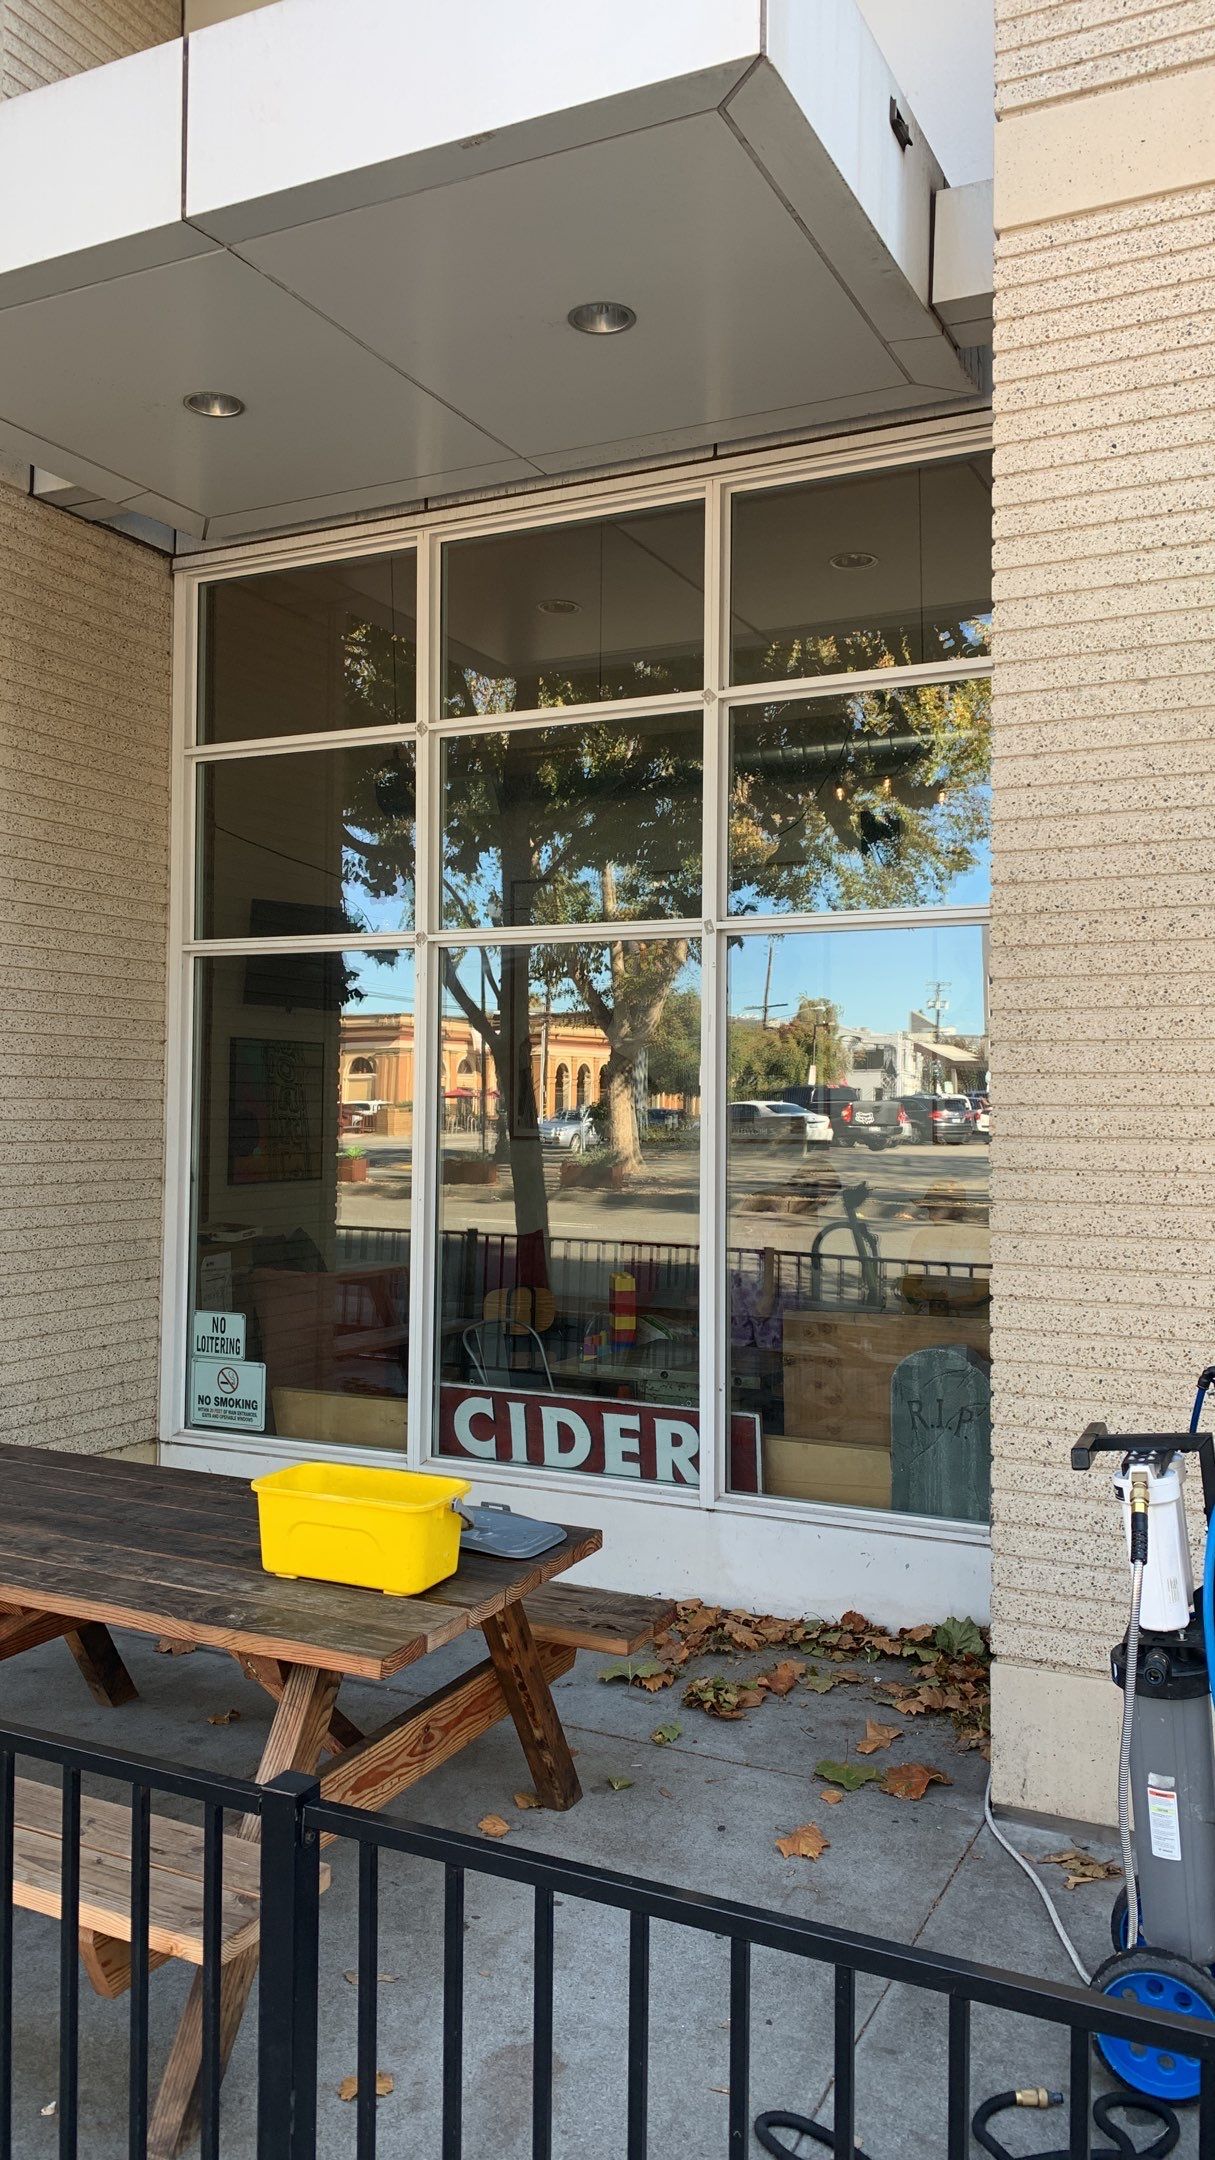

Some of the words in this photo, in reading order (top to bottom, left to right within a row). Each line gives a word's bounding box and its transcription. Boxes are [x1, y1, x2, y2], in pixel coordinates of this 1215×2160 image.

[212, 1317, 226, 1334] NO
[197, 1335, 241, 1355] LOITERING
[198, 1395, 211, 1405] NO
[214, 1397, 258, 1410] SMOKING
[453, 1396, 700, 1485] CIDER
